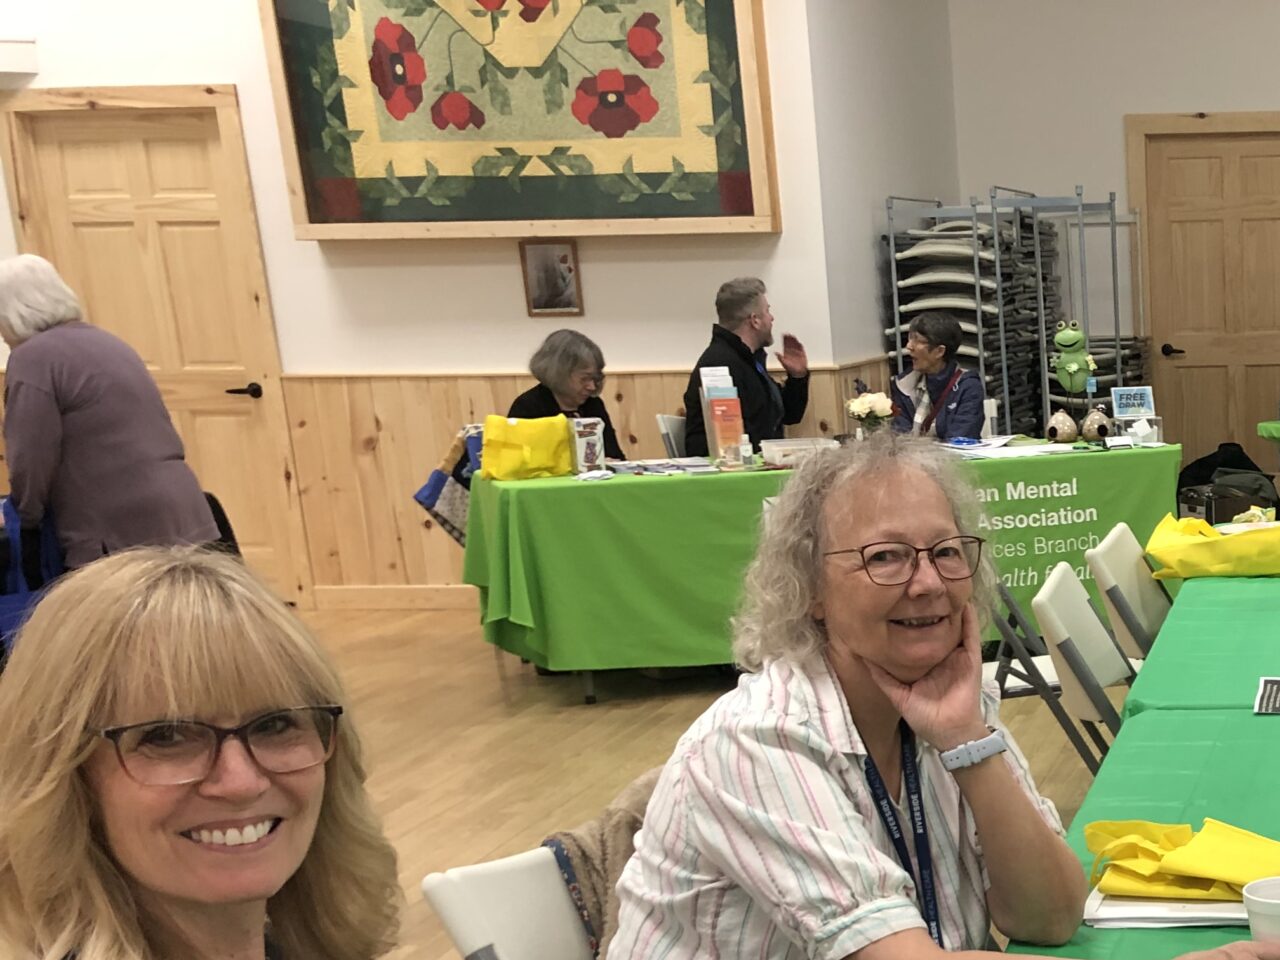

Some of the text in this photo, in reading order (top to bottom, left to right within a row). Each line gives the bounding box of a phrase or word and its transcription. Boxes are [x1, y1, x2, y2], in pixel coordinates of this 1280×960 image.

[1119, 393, 1146, 401] FREE
[1006, 477, 1078, 500] Mental
[977, 506, 1098, 531] Association
[1034, 531, 1100, 555] Branch
[880, 798, 901, 839] RIVERSIDE
[911, 793, 924, 834] RIVERSIDE
